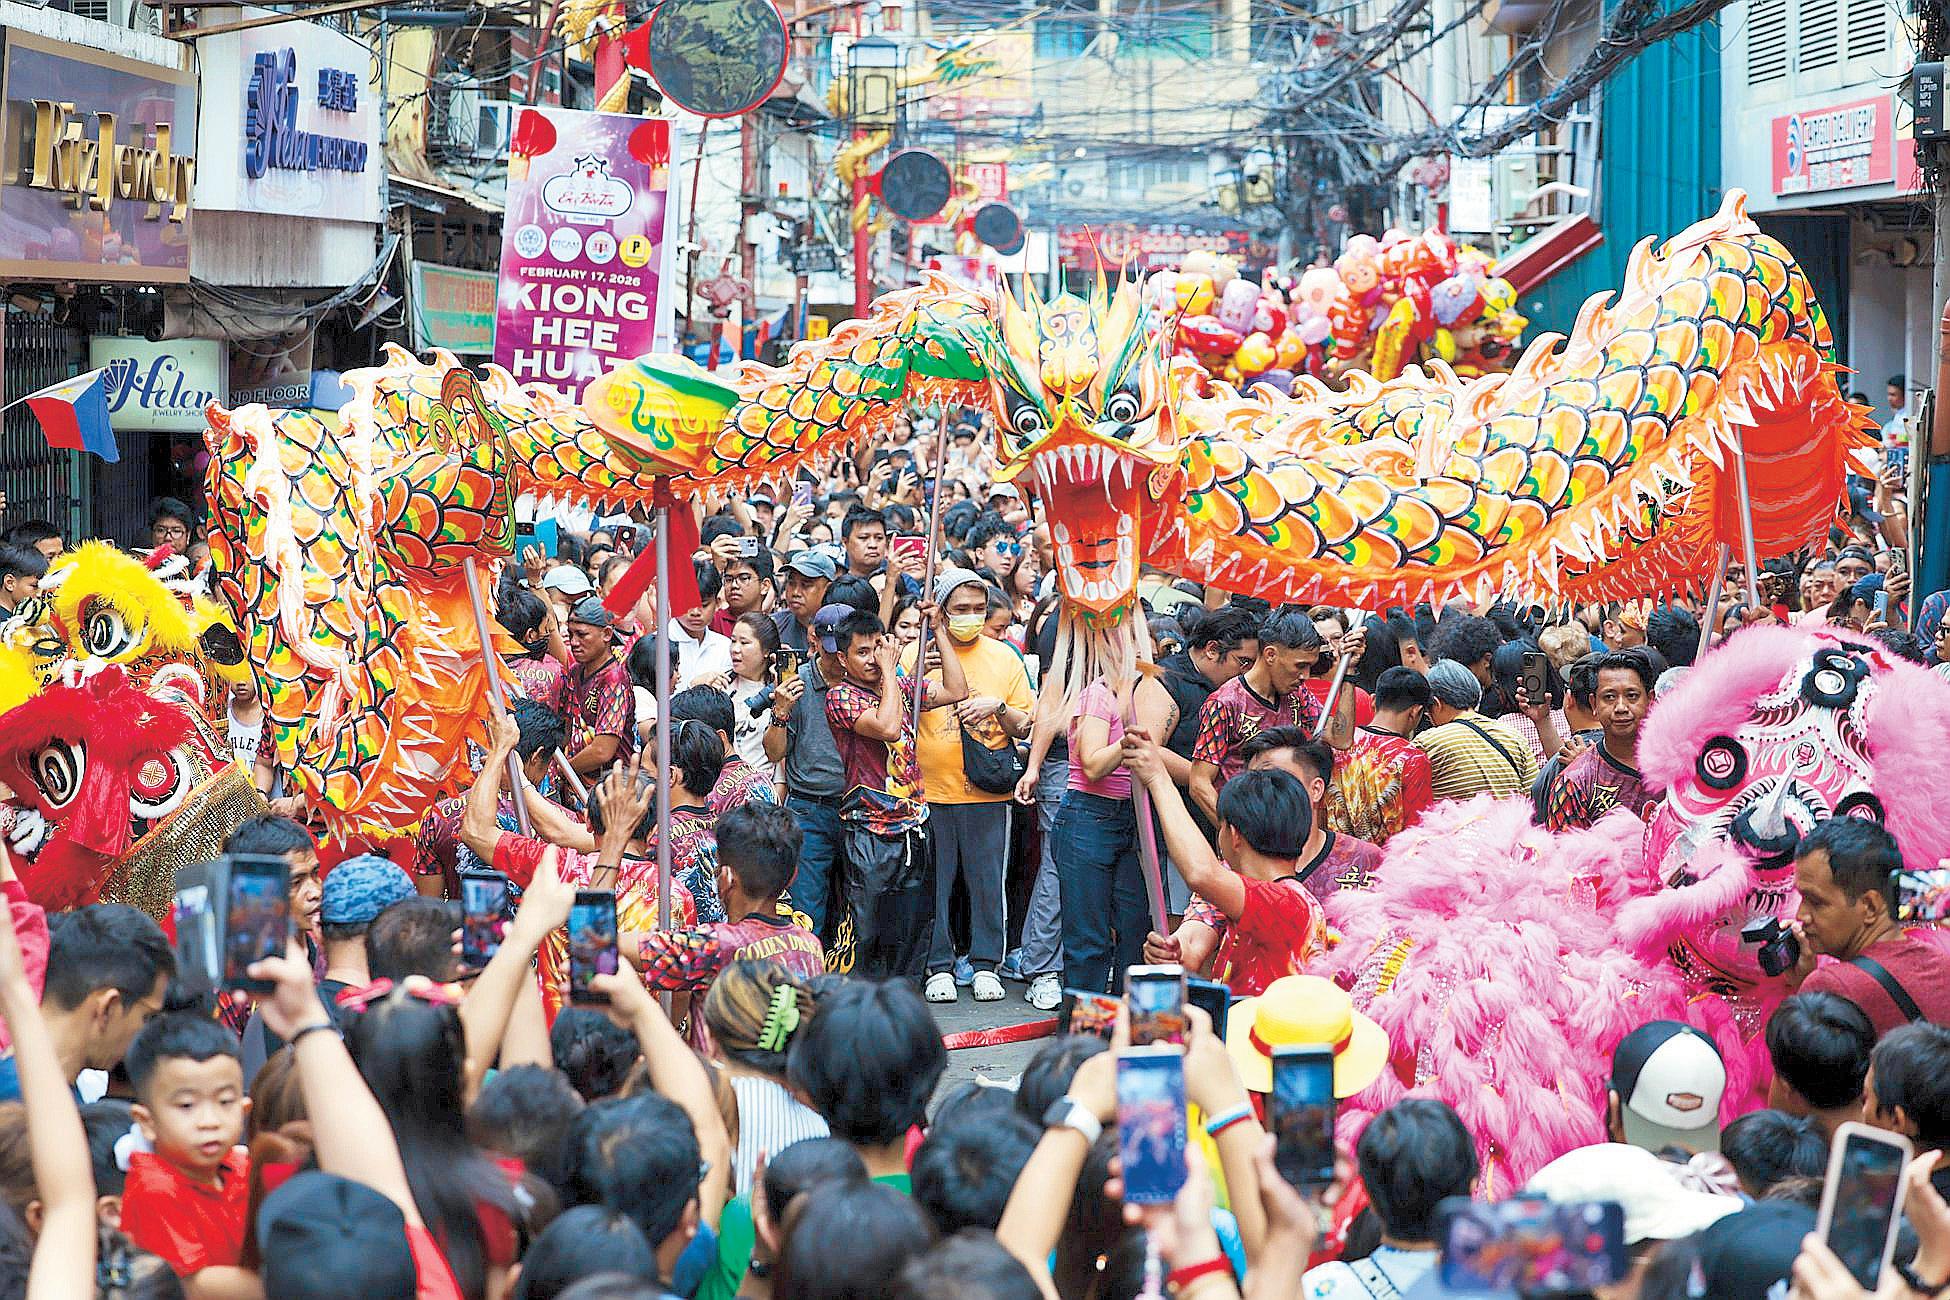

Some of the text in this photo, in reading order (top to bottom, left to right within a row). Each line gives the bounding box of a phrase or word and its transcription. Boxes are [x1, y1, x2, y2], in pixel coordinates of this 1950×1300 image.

[519, 266, 587, 281] FEBRUARY
[608, 274, 641, 287] 2026
[507, 282, 649, 321] KIONG
[532, 316, 620, 353] HEE
[100, 355, 213, 413] Helen
[254, 384, 310, 403] FLOOR
[152, 409, 182, 418] JEWELRY
